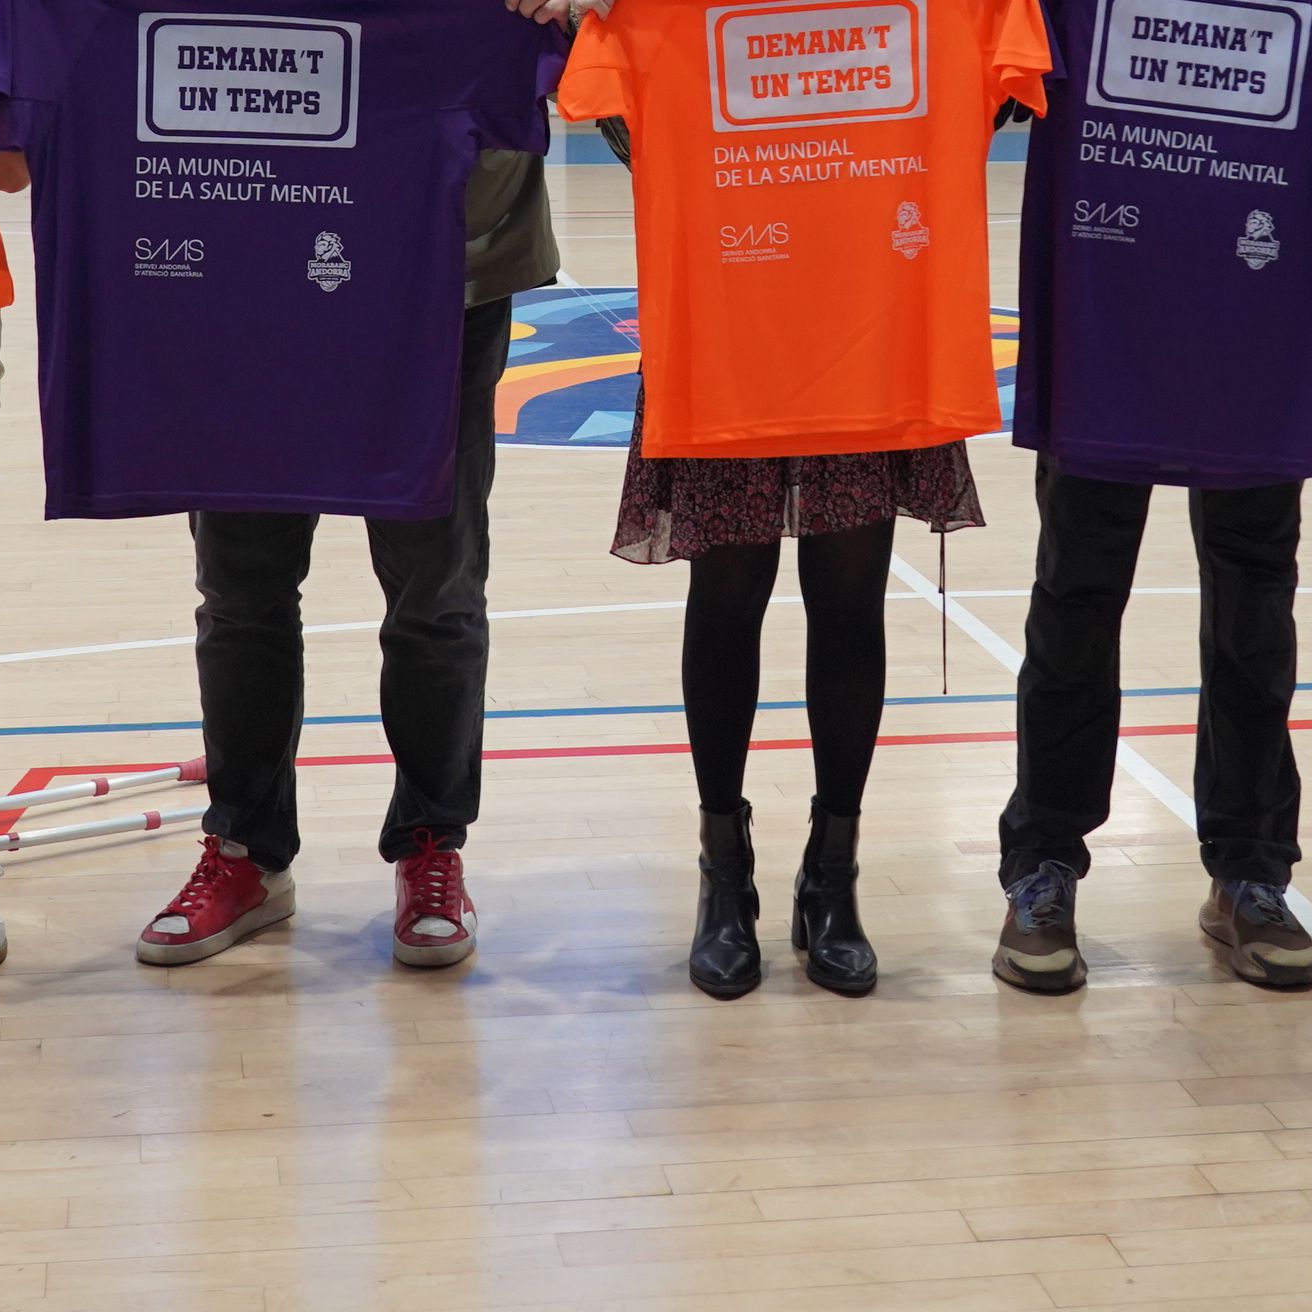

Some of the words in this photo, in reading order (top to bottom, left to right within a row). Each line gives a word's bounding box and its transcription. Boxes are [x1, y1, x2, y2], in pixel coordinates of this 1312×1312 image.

[747, 25, 890, 59] DEMANA'T
[1132, 16, 1273, 54] DEMANA'T
[178, 46, 323, 74] DEMANA'T
[1129, 56, 1168, 82] UN
[1177, 61, 1266, 95] TEMPS
[751, 73, 789, 99] UN
[798, 65, 891, 95] TEMPS
[178, 87, 218, 111] UN
[226, 88, 320, 115] TEMPS
[714, 146, 750, 164] DIA
[756, 139, 854, 162] MUNDIAL
[1082, 120, 1116, 141] DIA
[1122, 126, 1218, 153] MUNDIAL
[136, 157, 172, 174] DIA
[178, 158, 276, 178] MUNDIAL
[716, 170, 743, 188] DE
[748, 167, 773, 185] LA
[779, 162, 843, 183] SALUT
[849, 156, 928, 178] MENTAL
[1080, 144, 1105, 162] DE
[1111, 147, 1135, 167] LA
[1141, 151, 1206, 175] SALUT
[1209, 160, 1288, 186] MENTAL
[135, 180, 163, 198] DE
[169, 182, 194, 199] LA
[200, 182, 265, 202] SALUT
[271, 185, 354, 204] MENTAL
